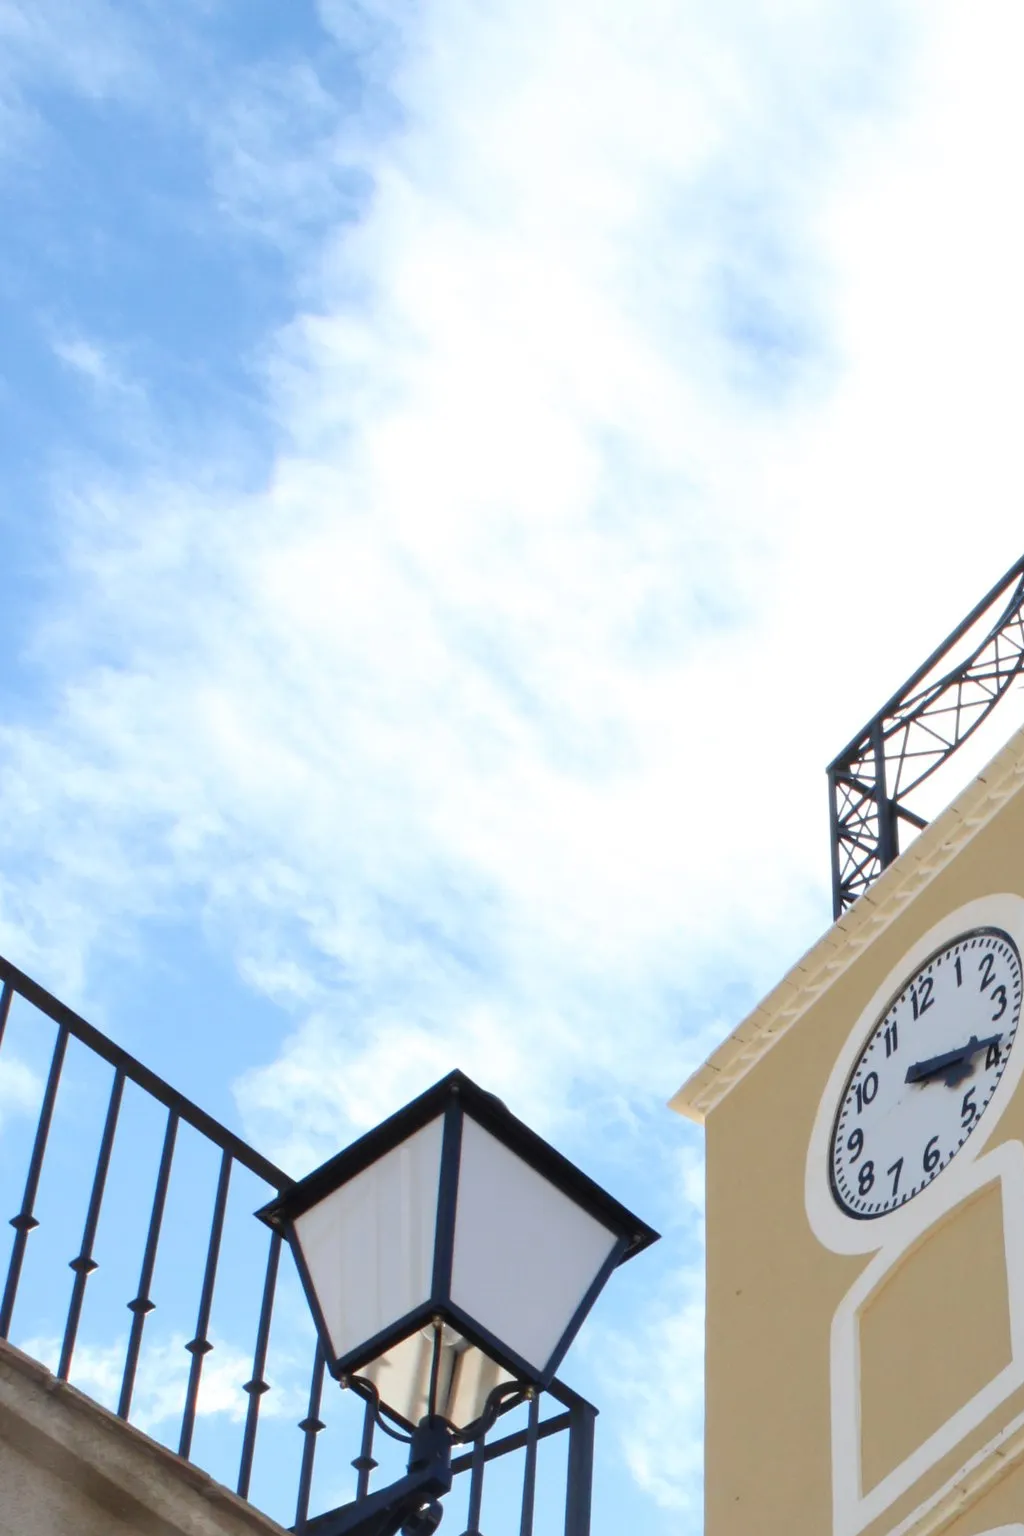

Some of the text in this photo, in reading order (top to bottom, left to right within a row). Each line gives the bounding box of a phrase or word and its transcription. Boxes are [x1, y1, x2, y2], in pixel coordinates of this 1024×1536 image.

[955, 957, 962, 987] 1
[979, 953, 994, 991] 2
[911, 978, 934, 1020] 12
[991, 985, 1007, 1020] 3
[884, 1024, 898, 1057] 11
[985, 1042, 1001, 1070] 4
[856, 1072, 878, 1114] 10
[962, 1087, 976, 1127] 5
[848, 1128, 864, 1163] 9
[923, 1136, 940, 1172] 6
[858, 1161, 874, 1195] 8
[888, 1157, 904, 1196] 7
